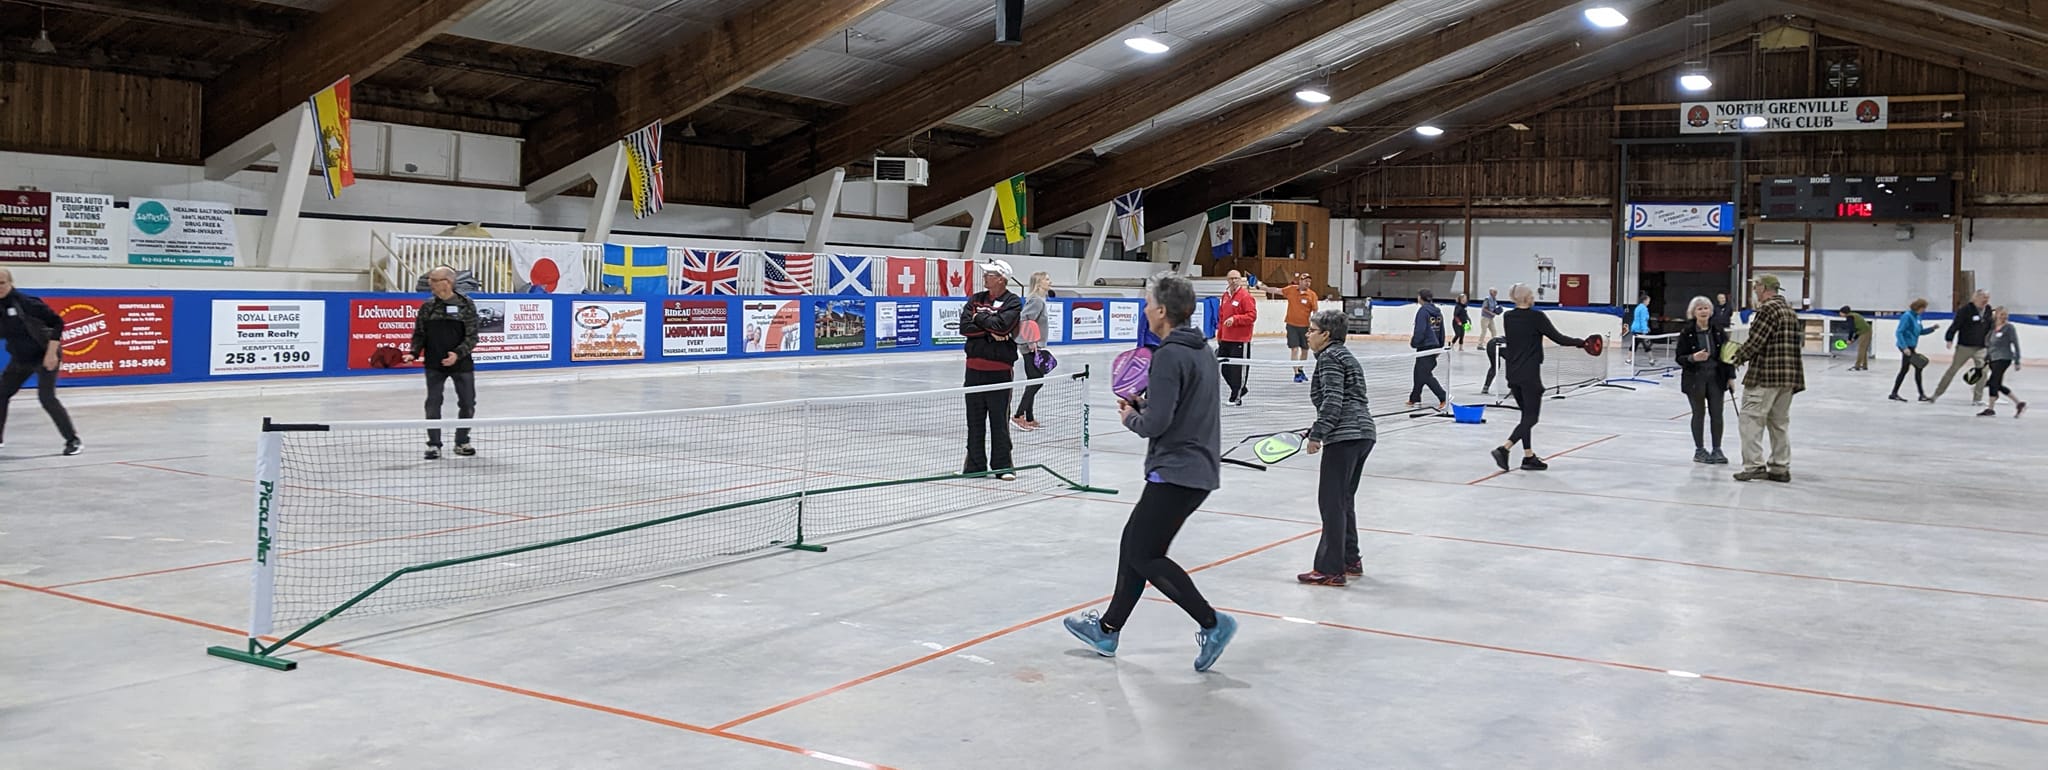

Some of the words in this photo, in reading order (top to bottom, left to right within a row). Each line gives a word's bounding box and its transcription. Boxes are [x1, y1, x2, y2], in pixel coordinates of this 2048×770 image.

[1716, 104, 1763, 115] NORTH
[1768, 101, 1849, 114] GRENVILLE
[1796, 116, 1833, 128] CLUB
[56, 195, 82, 204] PUBLIC
[84, 196, 103, 206] AUTO
[105, 198, 110, 206] &
[0, 204, 48, 216] RIDEAU
[62, 203, 104, 213] EQUIPMENT
[65, 211, 101, 221] AUCTIONS
[0, 228, 32, 237] CORNER
[33, 229, 45, 237] OF
[28, 237, 35, 246] &
[36, 238, 48, 246] 43
[358, 305, 404, 319] Lockwood
[405, 305, 420, 319] Bro
[519, 303, 540, 312] VALLEY
[664, 308, 691, 317] RIDEAU
[237, 313, 266, 322] ROYAL
[513, 313, 544, 322] SANITATION
[62, 320, 107, 341] NSSON'S
[378, 321, 416, 330] CONSTRUCTI
[510, 323, 536, 332] SERVICES
[535, 322, 548, 331] LTD.
[237, 330, 265, 338] Team
[267, 330, 299, 339] Realty
[665, 325, 708, 338] LIQUIDATION
[709, 325, 726, 337] SALE
[476, 335, 505, 343] 58-2333
[225, 352, 256, 364] 258
[273, 351, 311, 363] 1990
[119, 358, 167, 368] 258-5966
